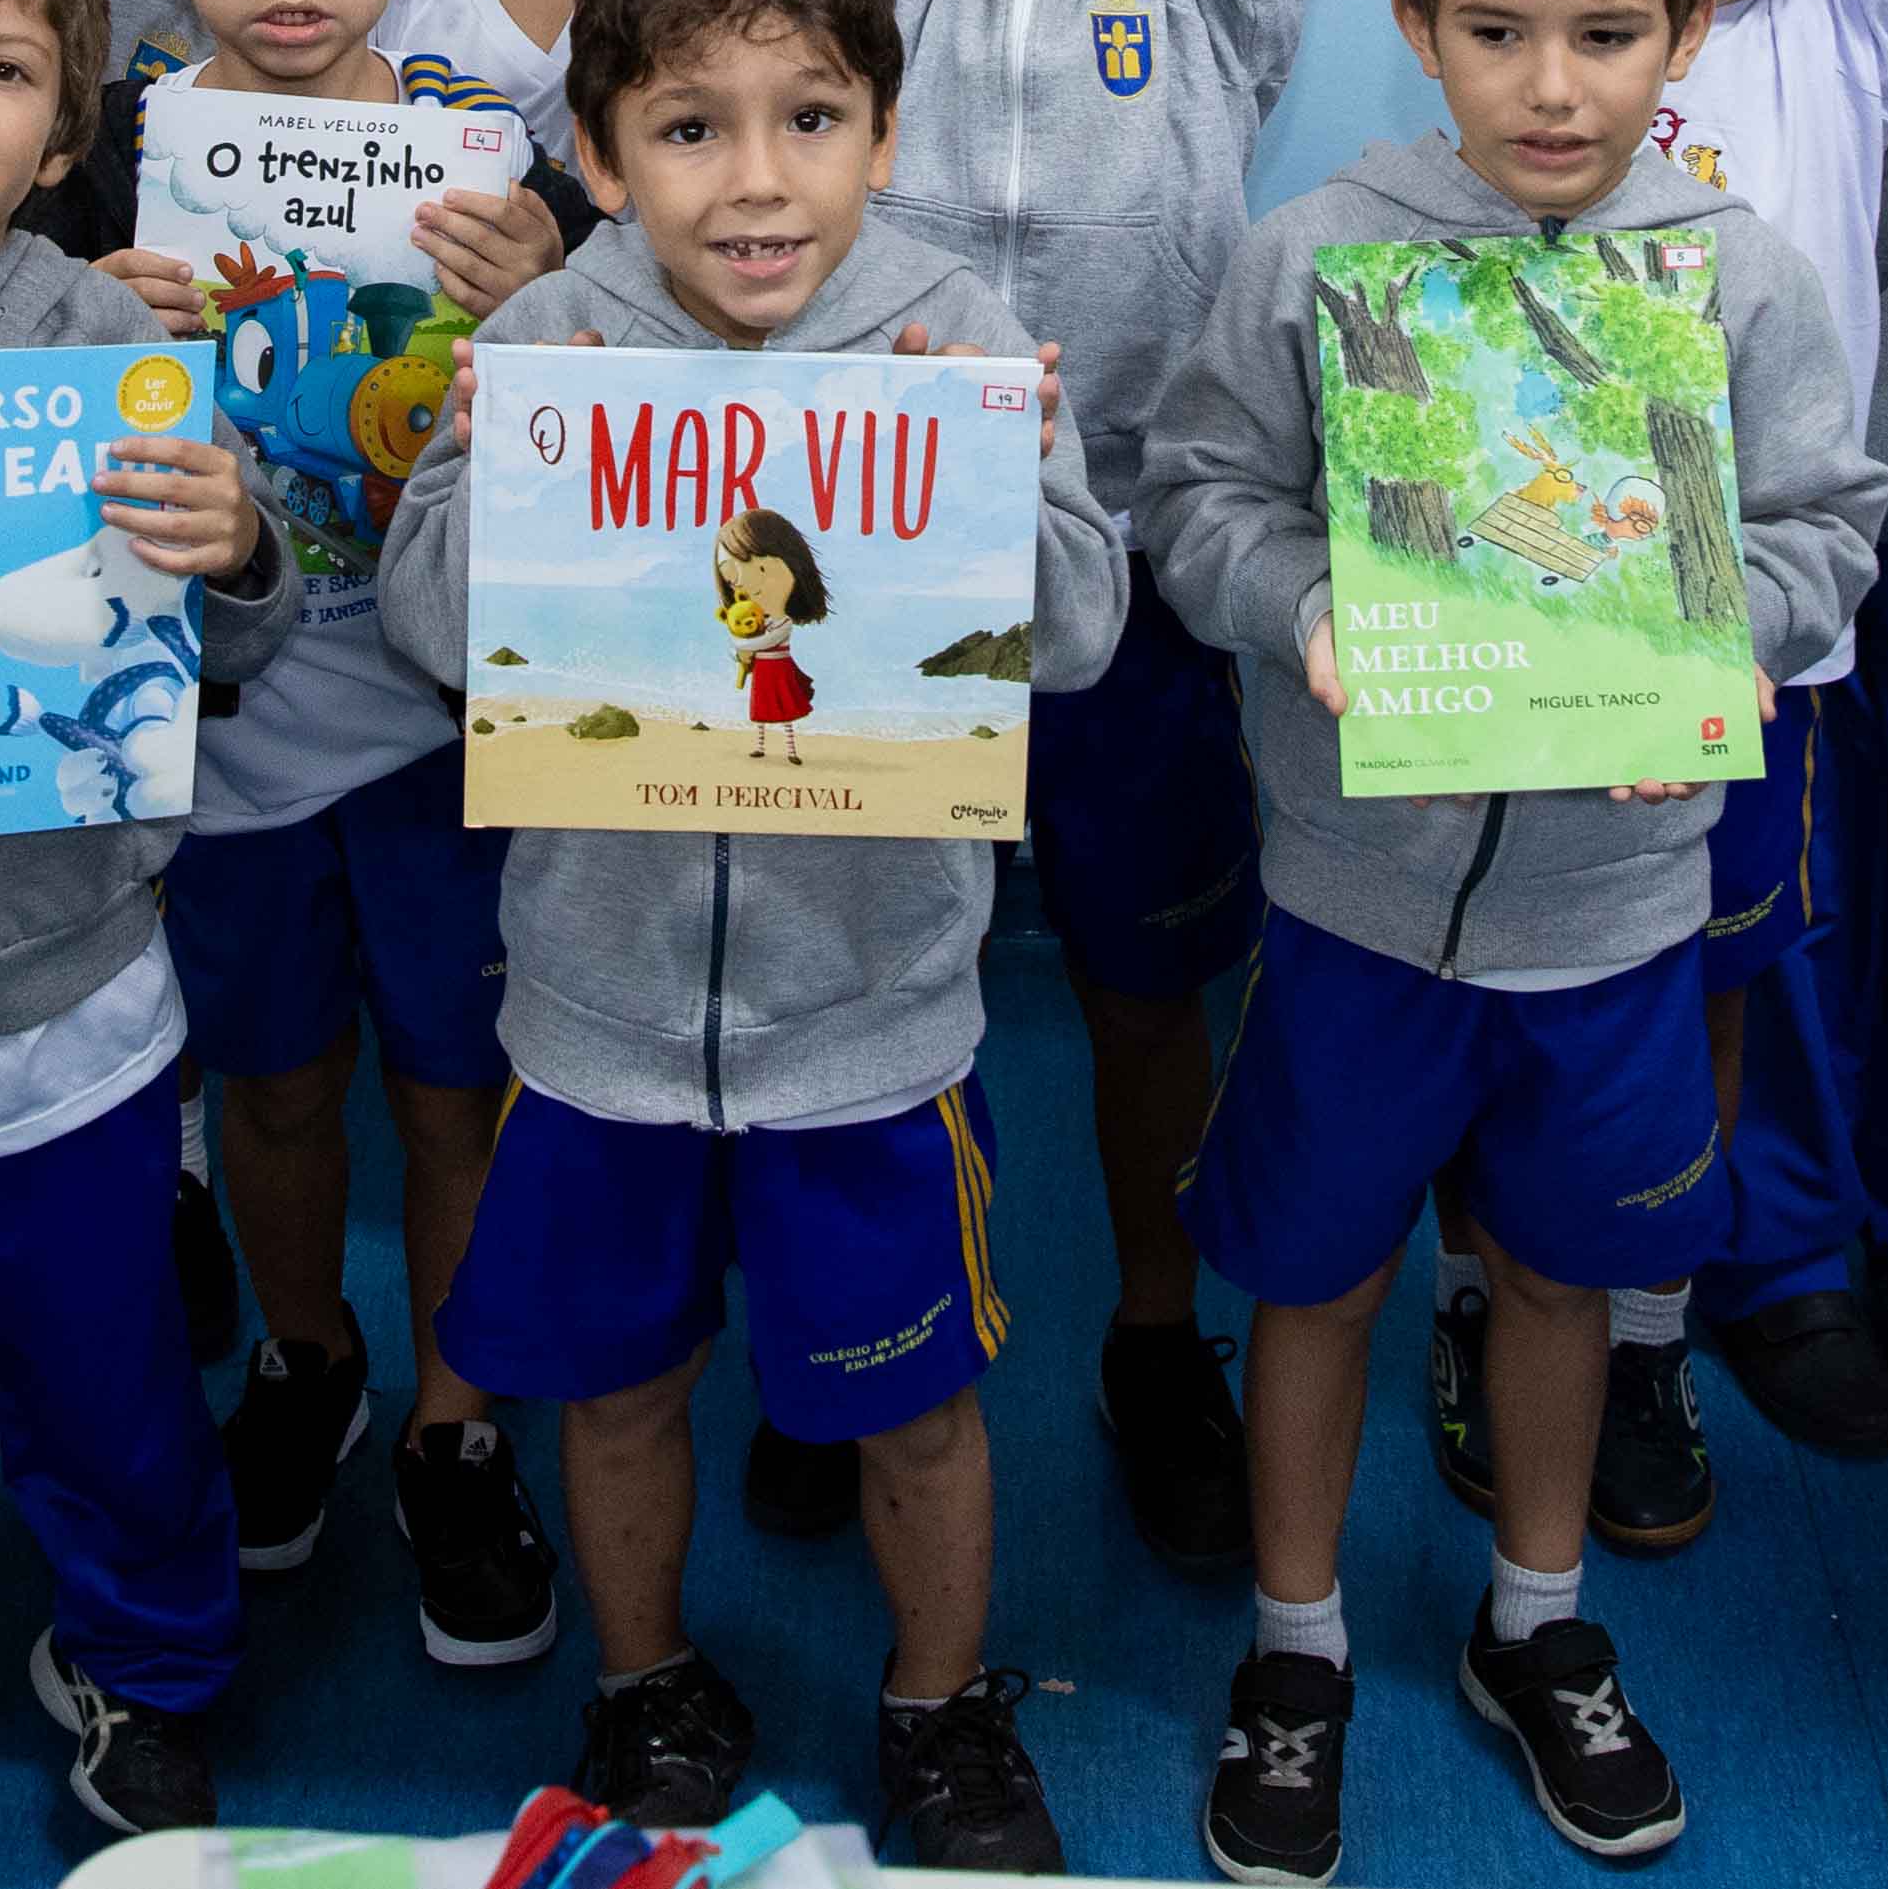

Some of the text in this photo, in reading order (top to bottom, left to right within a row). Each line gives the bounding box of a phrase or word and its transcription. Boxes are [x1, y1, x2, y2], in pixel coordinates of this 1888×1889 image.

[259, 114, 399, 133] MABEL VELLOSO
[207, 143, 241, 178] O
[284, 189, 356, 233] azul
[144, 377, 166, 391] Ler
[135, 398, 174, 413] Ouvir
[529, 403, 939, 541] O MAR VIU
[1346, 602, 1440, 633] MEU
[1349, 640, 1531, 674] MELHOR
[1350, 684, 1493, 717] AMIGO
[1529, 691, 1660, 710] MIGUEL TANCO
[1701, 741, 1728, 756] sm
[636, 783, 863, 812] TOM PERCIVAL
[875, 1338, 891, 1351] DE
[870, 1352, 886, 1365] DE
